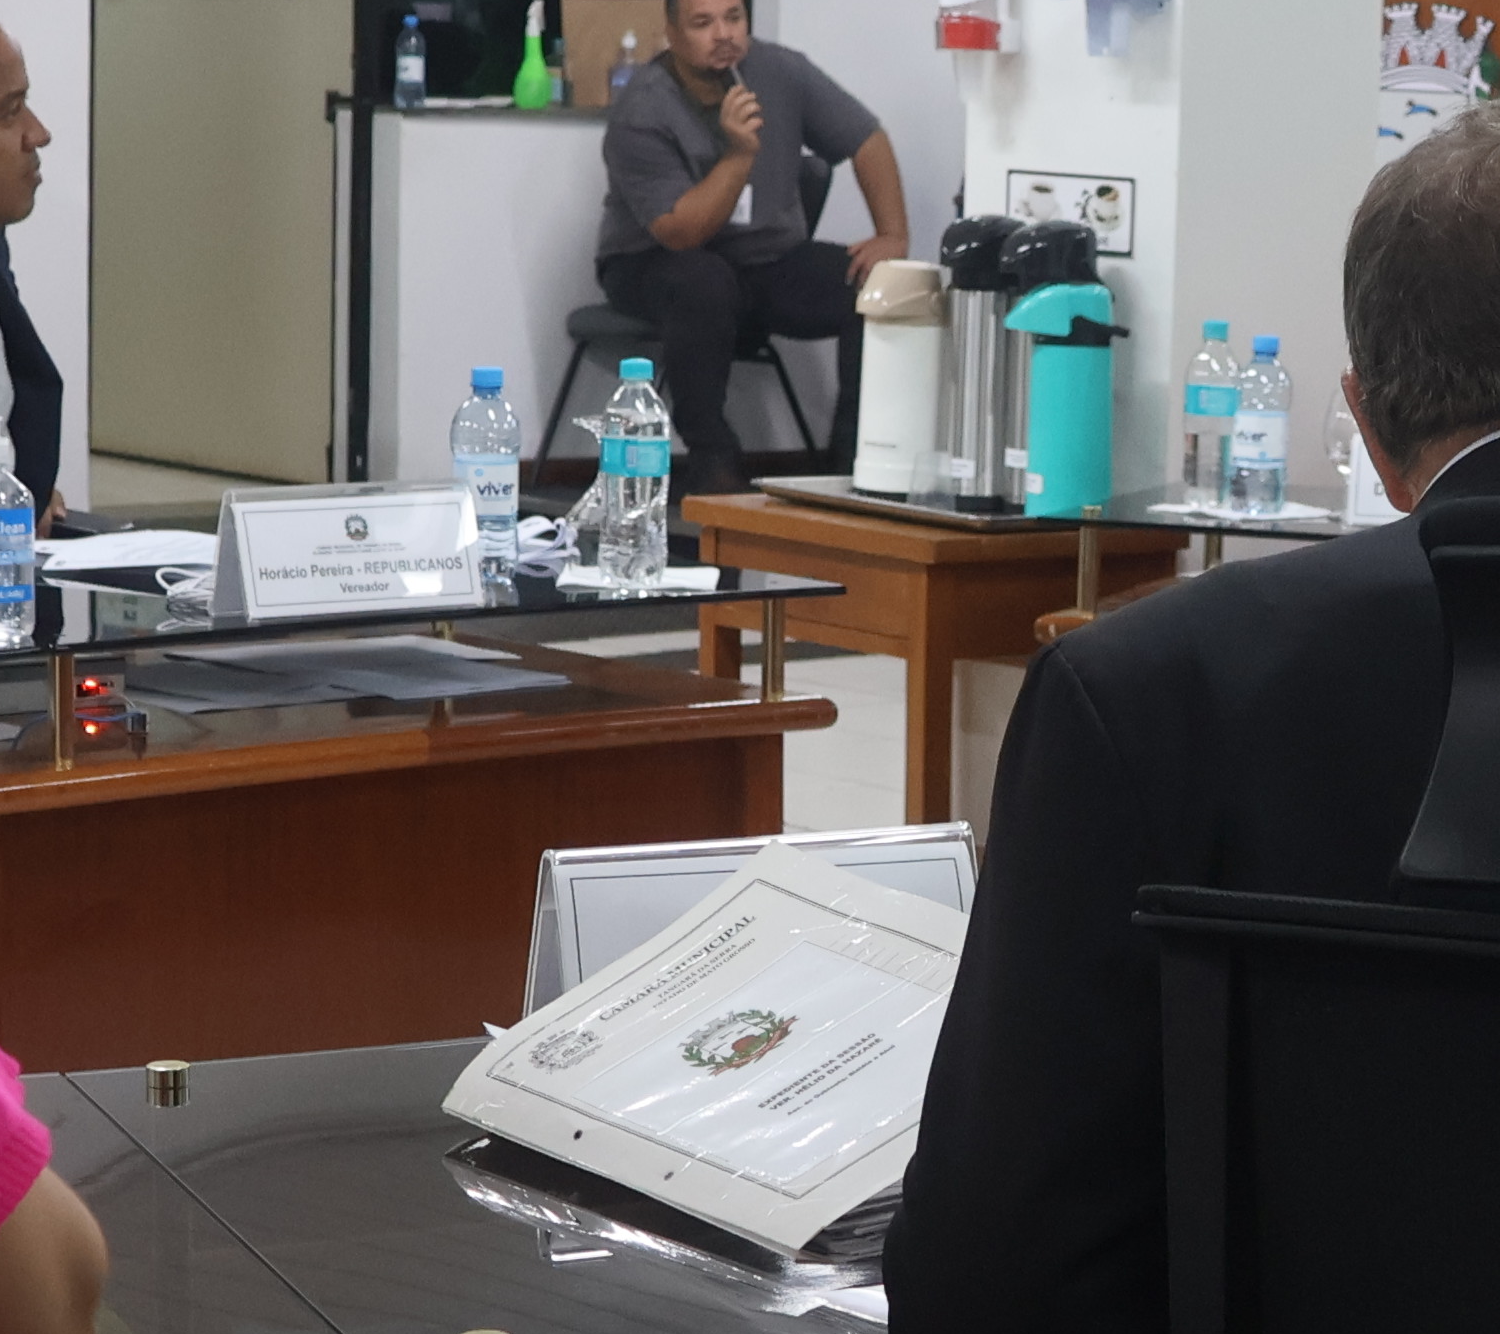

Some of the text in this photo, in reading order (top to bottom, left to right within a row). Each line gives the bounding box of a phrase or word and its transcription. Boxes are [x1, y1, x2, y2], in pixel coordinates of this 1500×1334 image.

[477, 482, 515, 497] viver
[259, 565, 307, 581] Horácio
[311, 563, 353, 578] Pereira
[364, 556, 463, 575] REPUBLICANOS
[340, 581, 389, 594] Vereador
[667, 915, 757, 980] MUNICIPAL
[757, 1067, 821, 1110] EXPEDIENTE
[820, 1058, 837, 1070] DA
[768, 1095, 796, 1112] VER.
[826, 1064, 844, 1076] DA
